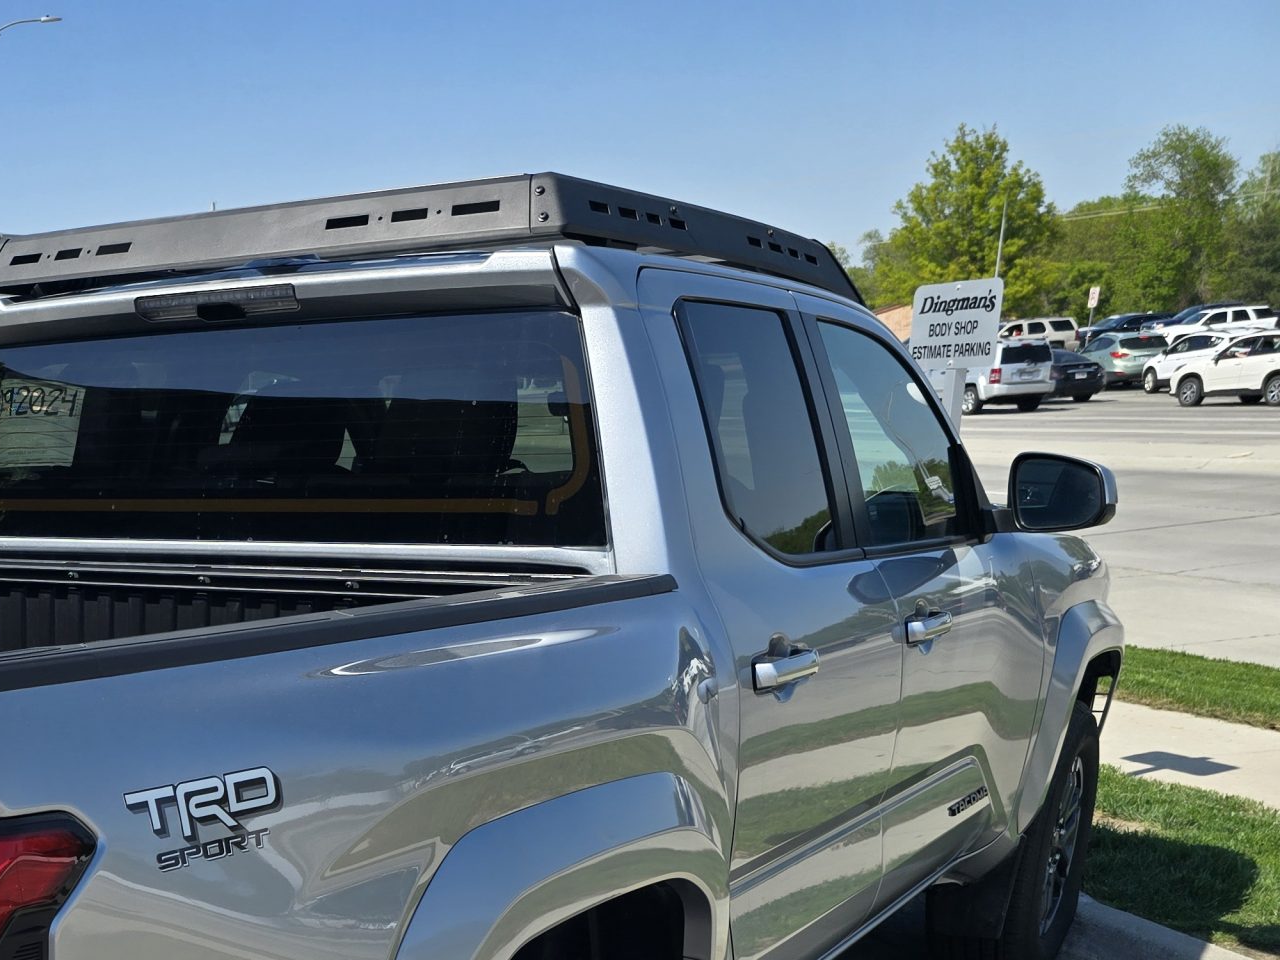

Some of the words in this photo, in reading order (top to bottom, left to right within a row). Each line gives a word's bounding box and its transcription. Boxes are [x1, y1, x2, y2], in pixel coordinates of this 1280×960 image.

[919, 289, 997, 316] Dingman's
[928, 322, 953, 338] BODY
[953, 320, 979, 336] SHOP
[912, 343, 952, 360] ESTIMATE
[953, 341, 991, 357] PARKING
[123, 766, 284, 844] TRD
[947, 785, 989, 816] TACOMA
[155, 828, 270, 872] SPORT
